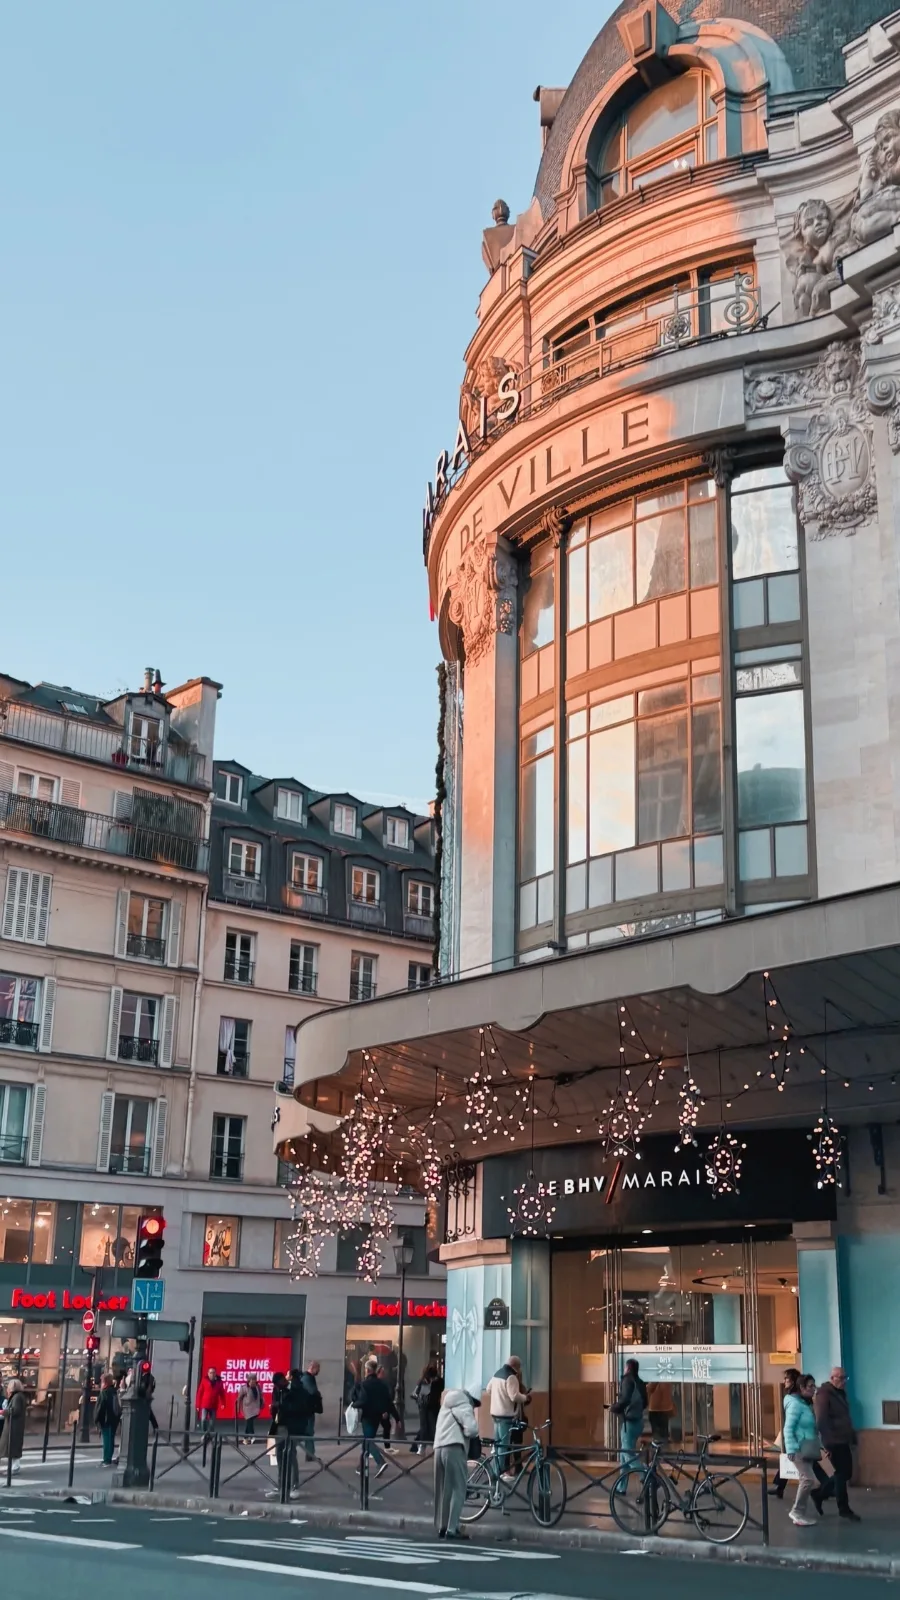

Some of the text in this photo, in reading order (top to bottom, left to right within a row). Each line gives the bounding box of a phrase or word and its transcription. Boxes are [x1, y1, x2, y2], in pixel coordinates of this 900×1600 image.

[460, 402, 649, 558] DE VILLE
[12, 1288, 56, 1309] Foot
[226, 1359, 269, 1370] SUR UNE
[213, 1535, 561, 1564] BUS
